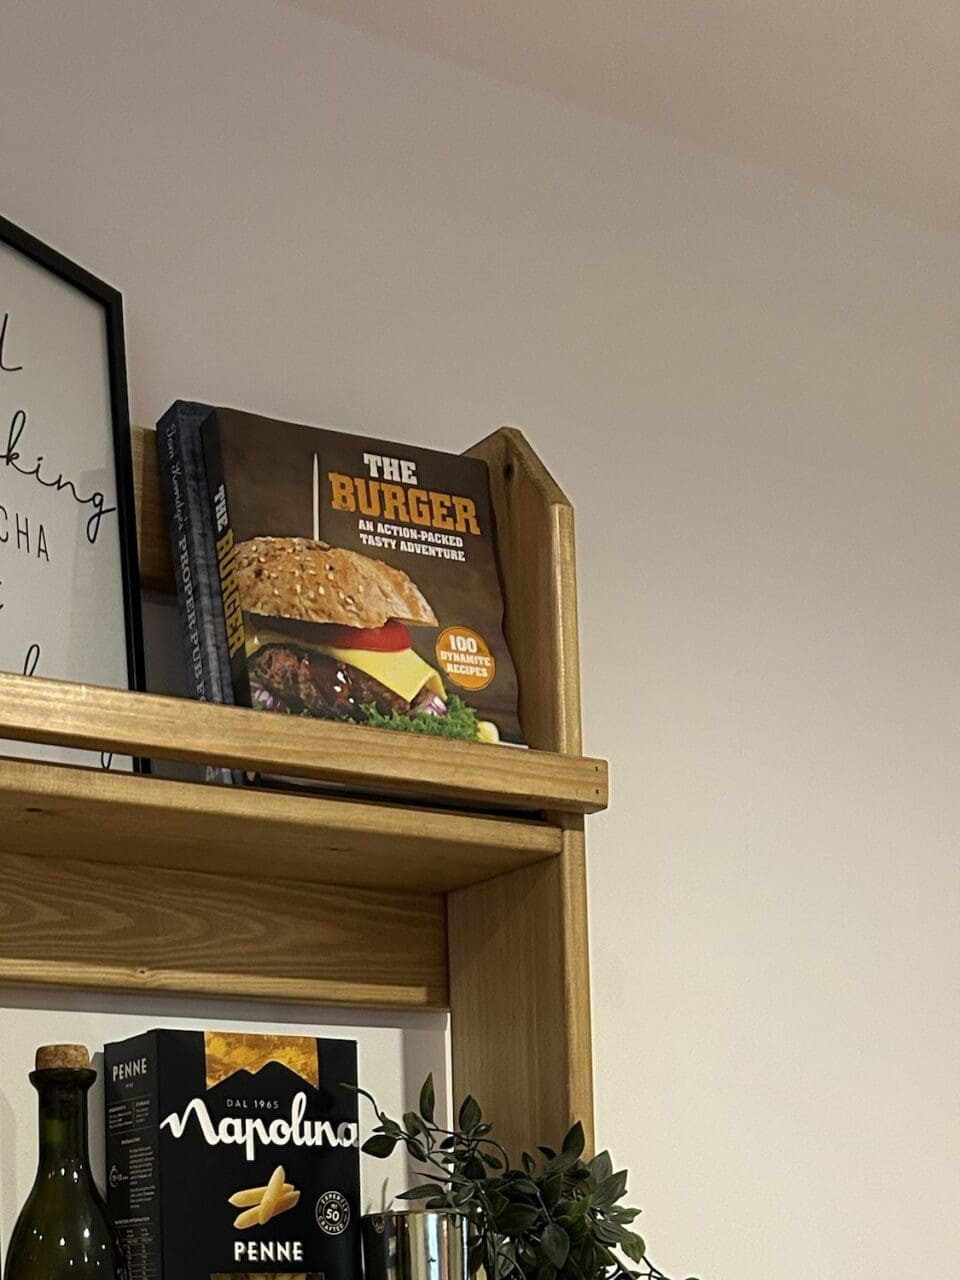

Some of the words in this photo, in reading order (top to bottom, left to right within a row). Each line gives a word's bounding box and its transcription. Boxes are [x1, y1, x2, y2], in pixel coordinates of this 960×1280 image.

[363, 452, 418, 485] THE
[214, 484, 228, 533] THE
[328, 472, 481, 535] BURGER
[358, 519, 375, 532] AN
[376, 522, 464, 548] ACTION-PACKED
[359, 533, 397, 549] TASTY
[400, 540, 466, 562] ADVENTURE
[216, 527, 246, 659] BURGER
[178, 534, 199, 631] PROPER
[190, 629, 205, 681] PUB
[449, 634, 478, 653] 100
[440, 650, 491, 667] DYNAMITE
[446, 662, 489, 678] RECIPES
[112, 1058, 148, 1082] PENNE
[226, 1099, 248, 1109] DAL
[254, 1099, 279, 1110] 1965
[159, 1091, 359, 1161] Napolina
[318, 1215, 344, 1232] CRAFTED
[326, 1208, 340, 1222] 50
[234, 1241, 304, 1262] PENNE
